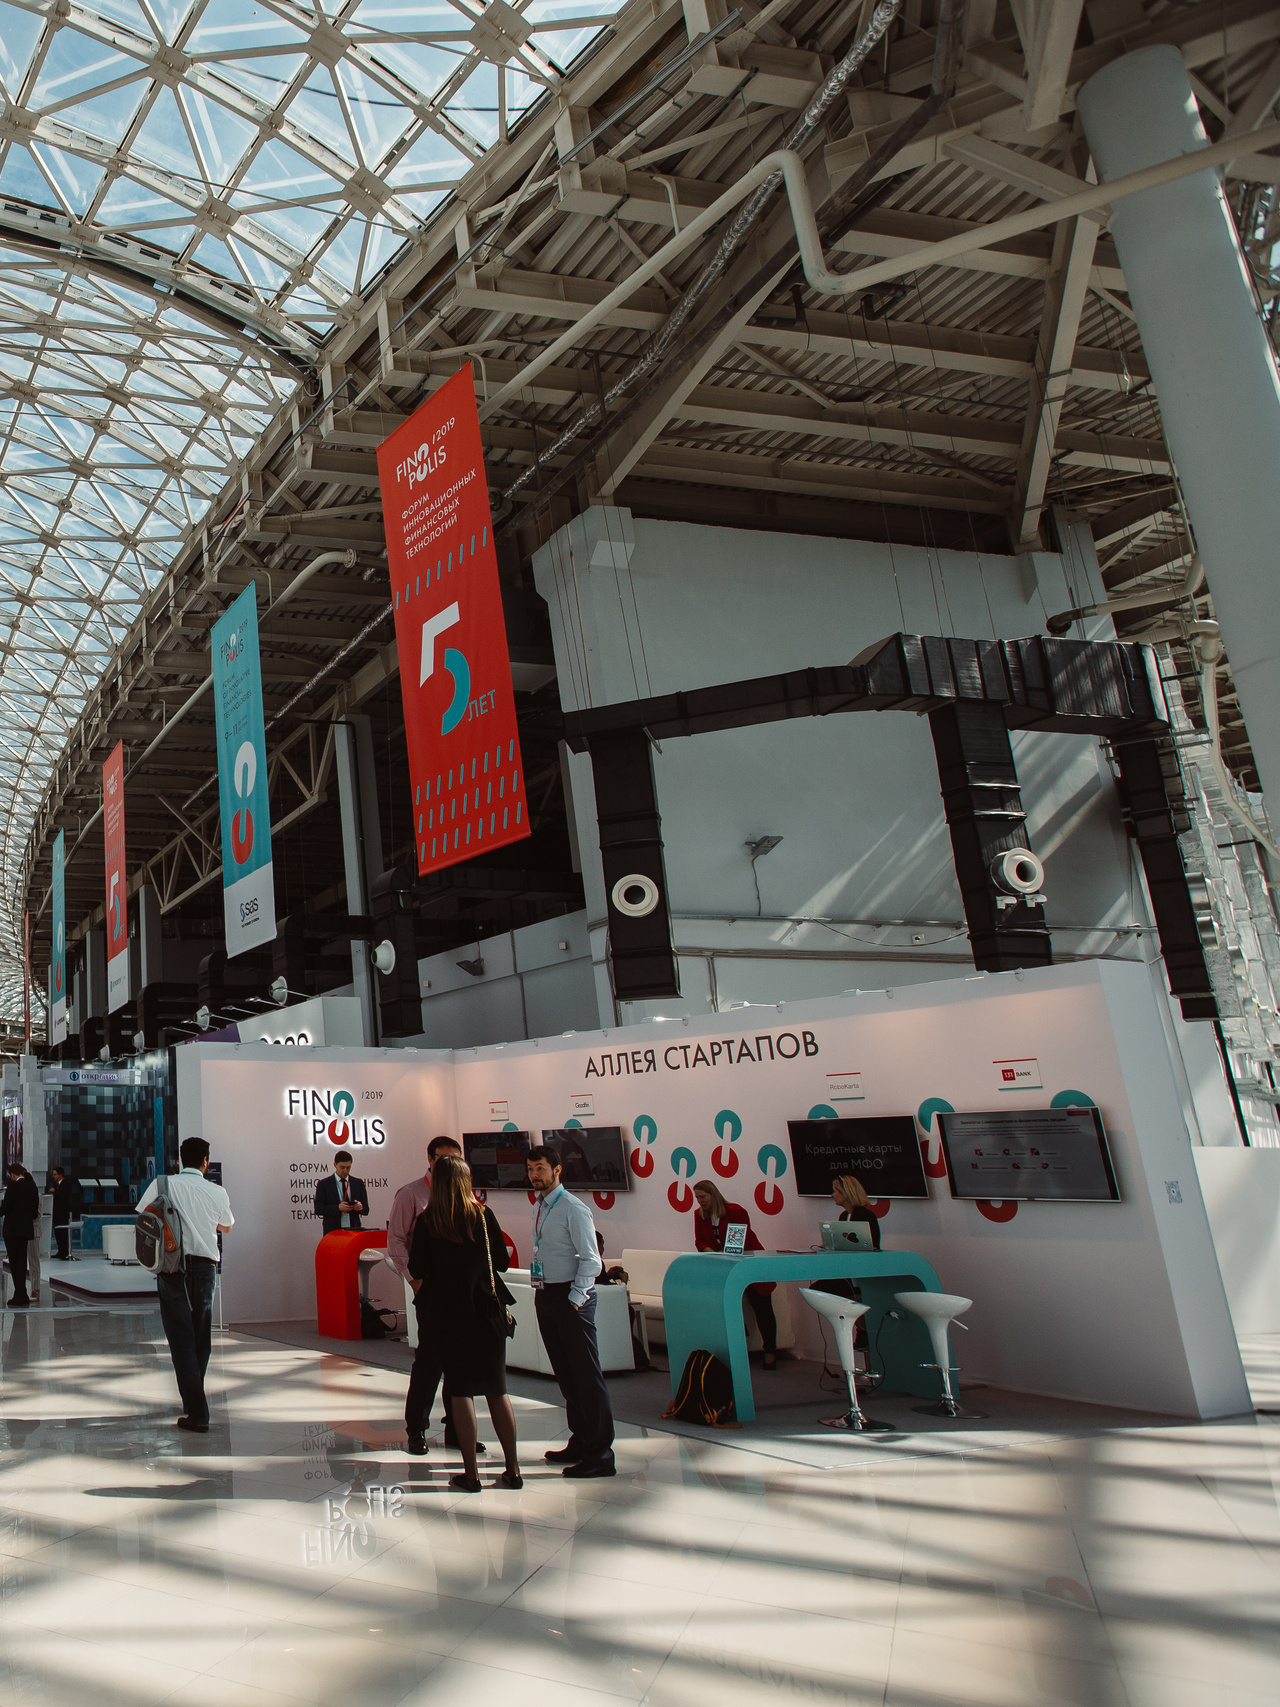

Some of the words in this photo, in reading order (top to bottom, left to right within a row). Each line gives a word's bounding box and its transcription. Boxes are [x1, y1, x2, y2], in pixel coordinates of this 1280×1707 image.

[402, 492, 430, 520] ФОРУМ
[403, 468, 477, 534] ИННОВАЦИОННЫХ
[404, 496, 461, 546] ФИНАНСОВЫХ
[406, 513, 458, 560] ТЕХНОЛОГИЙ
[468, 689, 496, 722] ЛЕТ
[584, 1049, 657, 1079] АЛЛЕЯ
[664, 1030, 820, 1072] СТАРТАПОВ
[830, 1083, 860, 1091] RoboKarta
[312, 1118, 385, 1146] POLIS
[805, 1144, 866, 1156] Кредитные
[868, 1144, 902, 1156] карты
[290, 1162, 329, 1173] ФОРУМ
[830, 1161, 849, 1171] для
[852, 1158, 884, 1170] МФО
